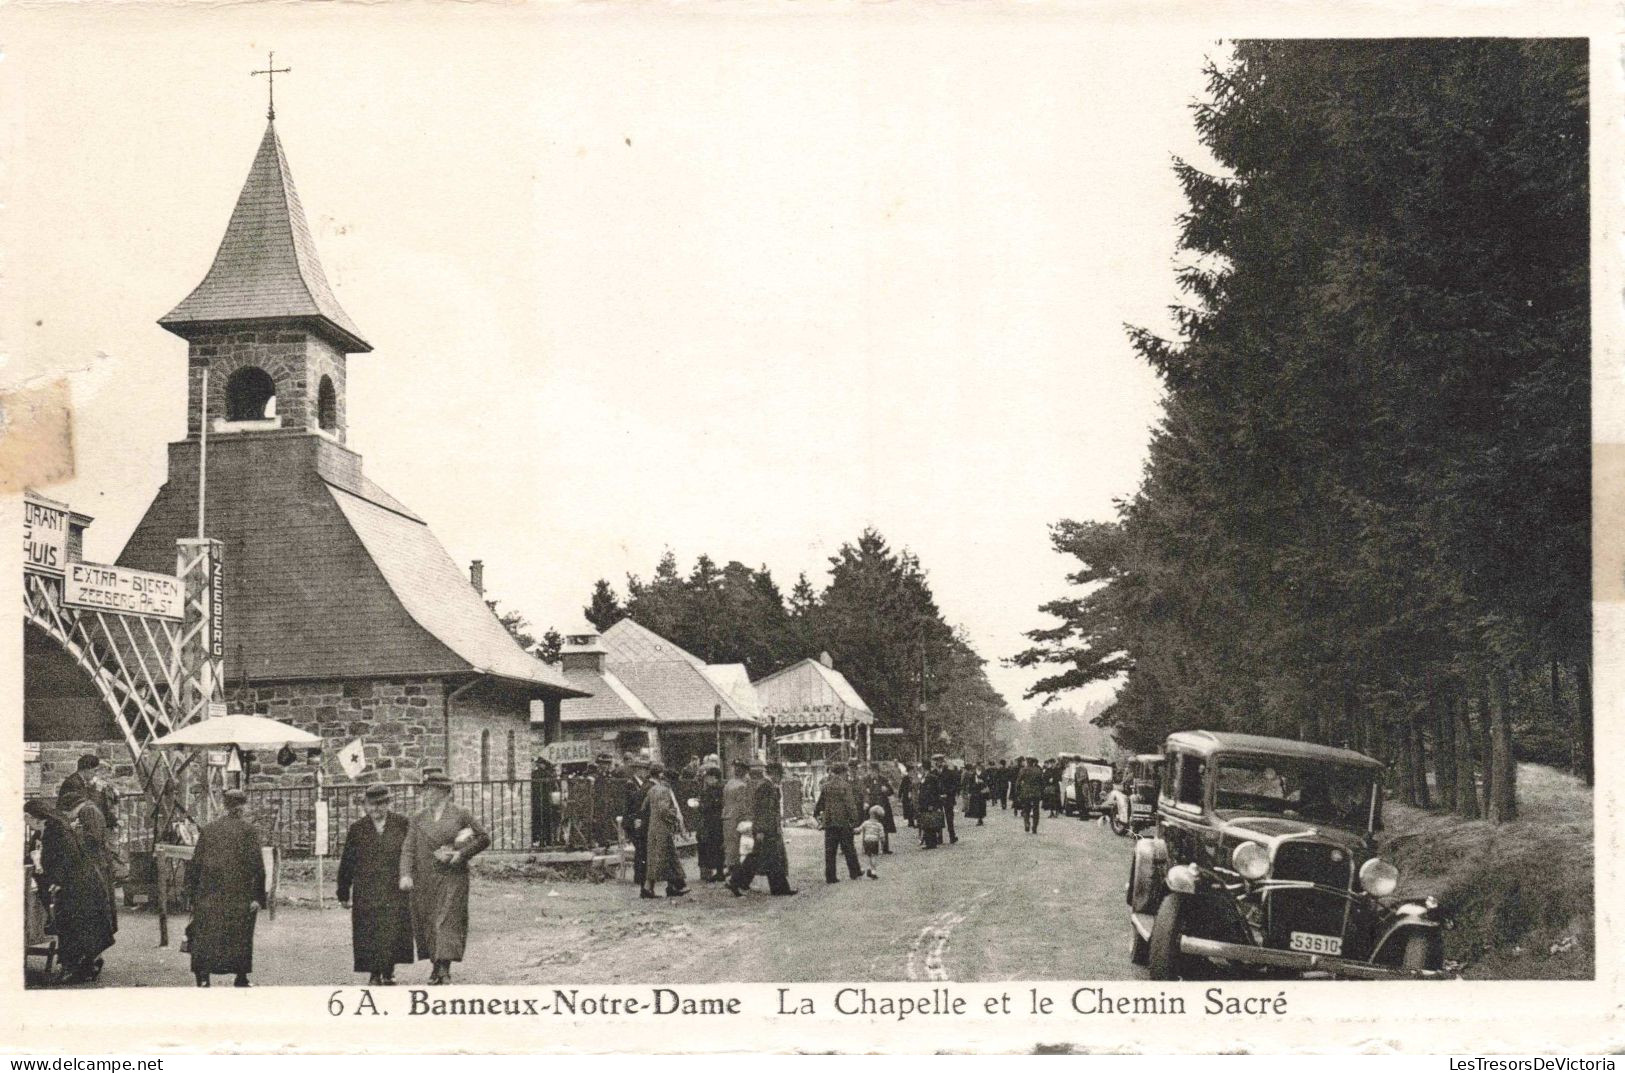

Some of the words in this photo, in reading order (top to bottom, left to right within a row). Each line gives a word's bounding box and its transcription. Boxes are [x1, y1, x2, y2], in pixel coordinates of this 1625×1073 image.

[73, 567, 117, 588] EXTRA
[132, 576, 178, 597] BIEREN
[79, 587, 136, 609] ZEEBERG
[212, 562, 223, 656] ZEEBERG
[1295, 934, 1338, 953] 53610
